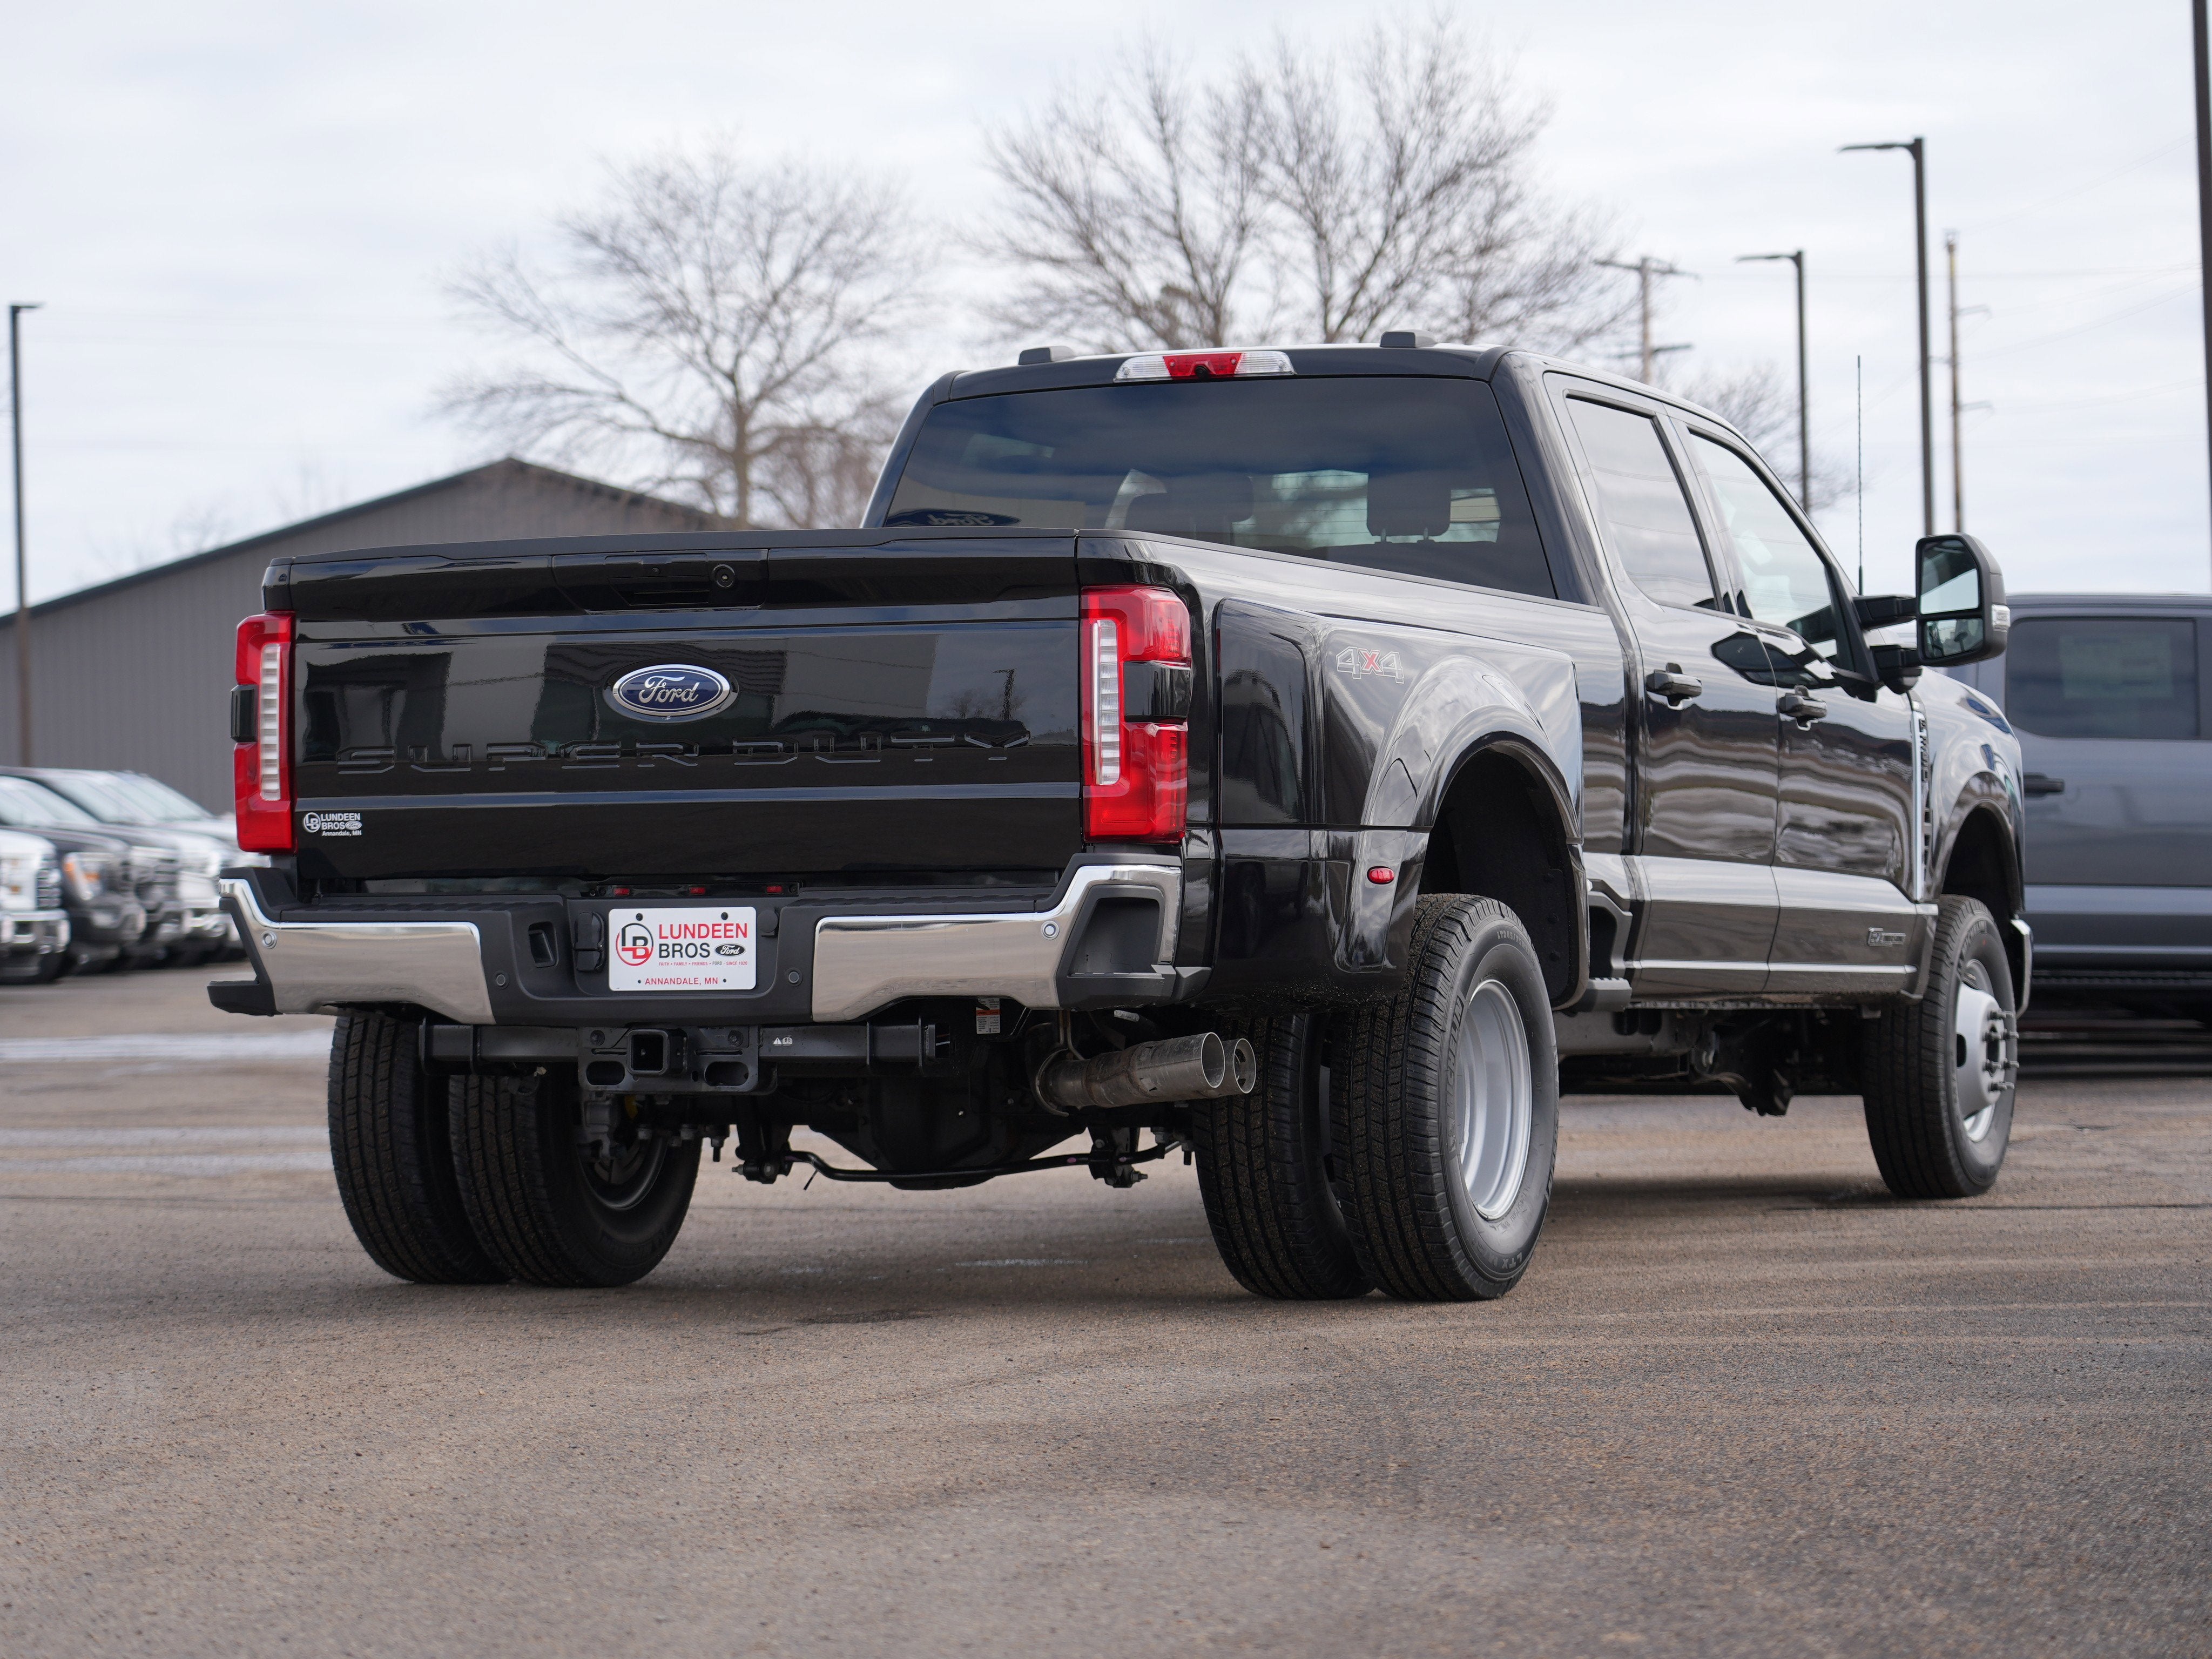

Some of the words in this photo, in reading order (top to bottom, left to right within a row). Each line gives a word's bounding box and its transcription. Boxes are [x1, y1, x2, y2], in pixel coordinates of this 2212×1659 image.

[639, 675, 700, 703] Ford
[337, 739, 700, 774] SUPER
[733, 729, 1030, 765] DUTY
[321, 813, 361, 821] LUNDEEN
[321, 821, 345, 830] BROS
[659, 923, 748, 939] LUNDEEN
[659, 942, 711, 959] BROS
[645, 977, 702, 986] ANNANDALE,
[1446, 994, 1465, 1120] MICHELIN
[1501, 1252, 1522, 1270] LTX
